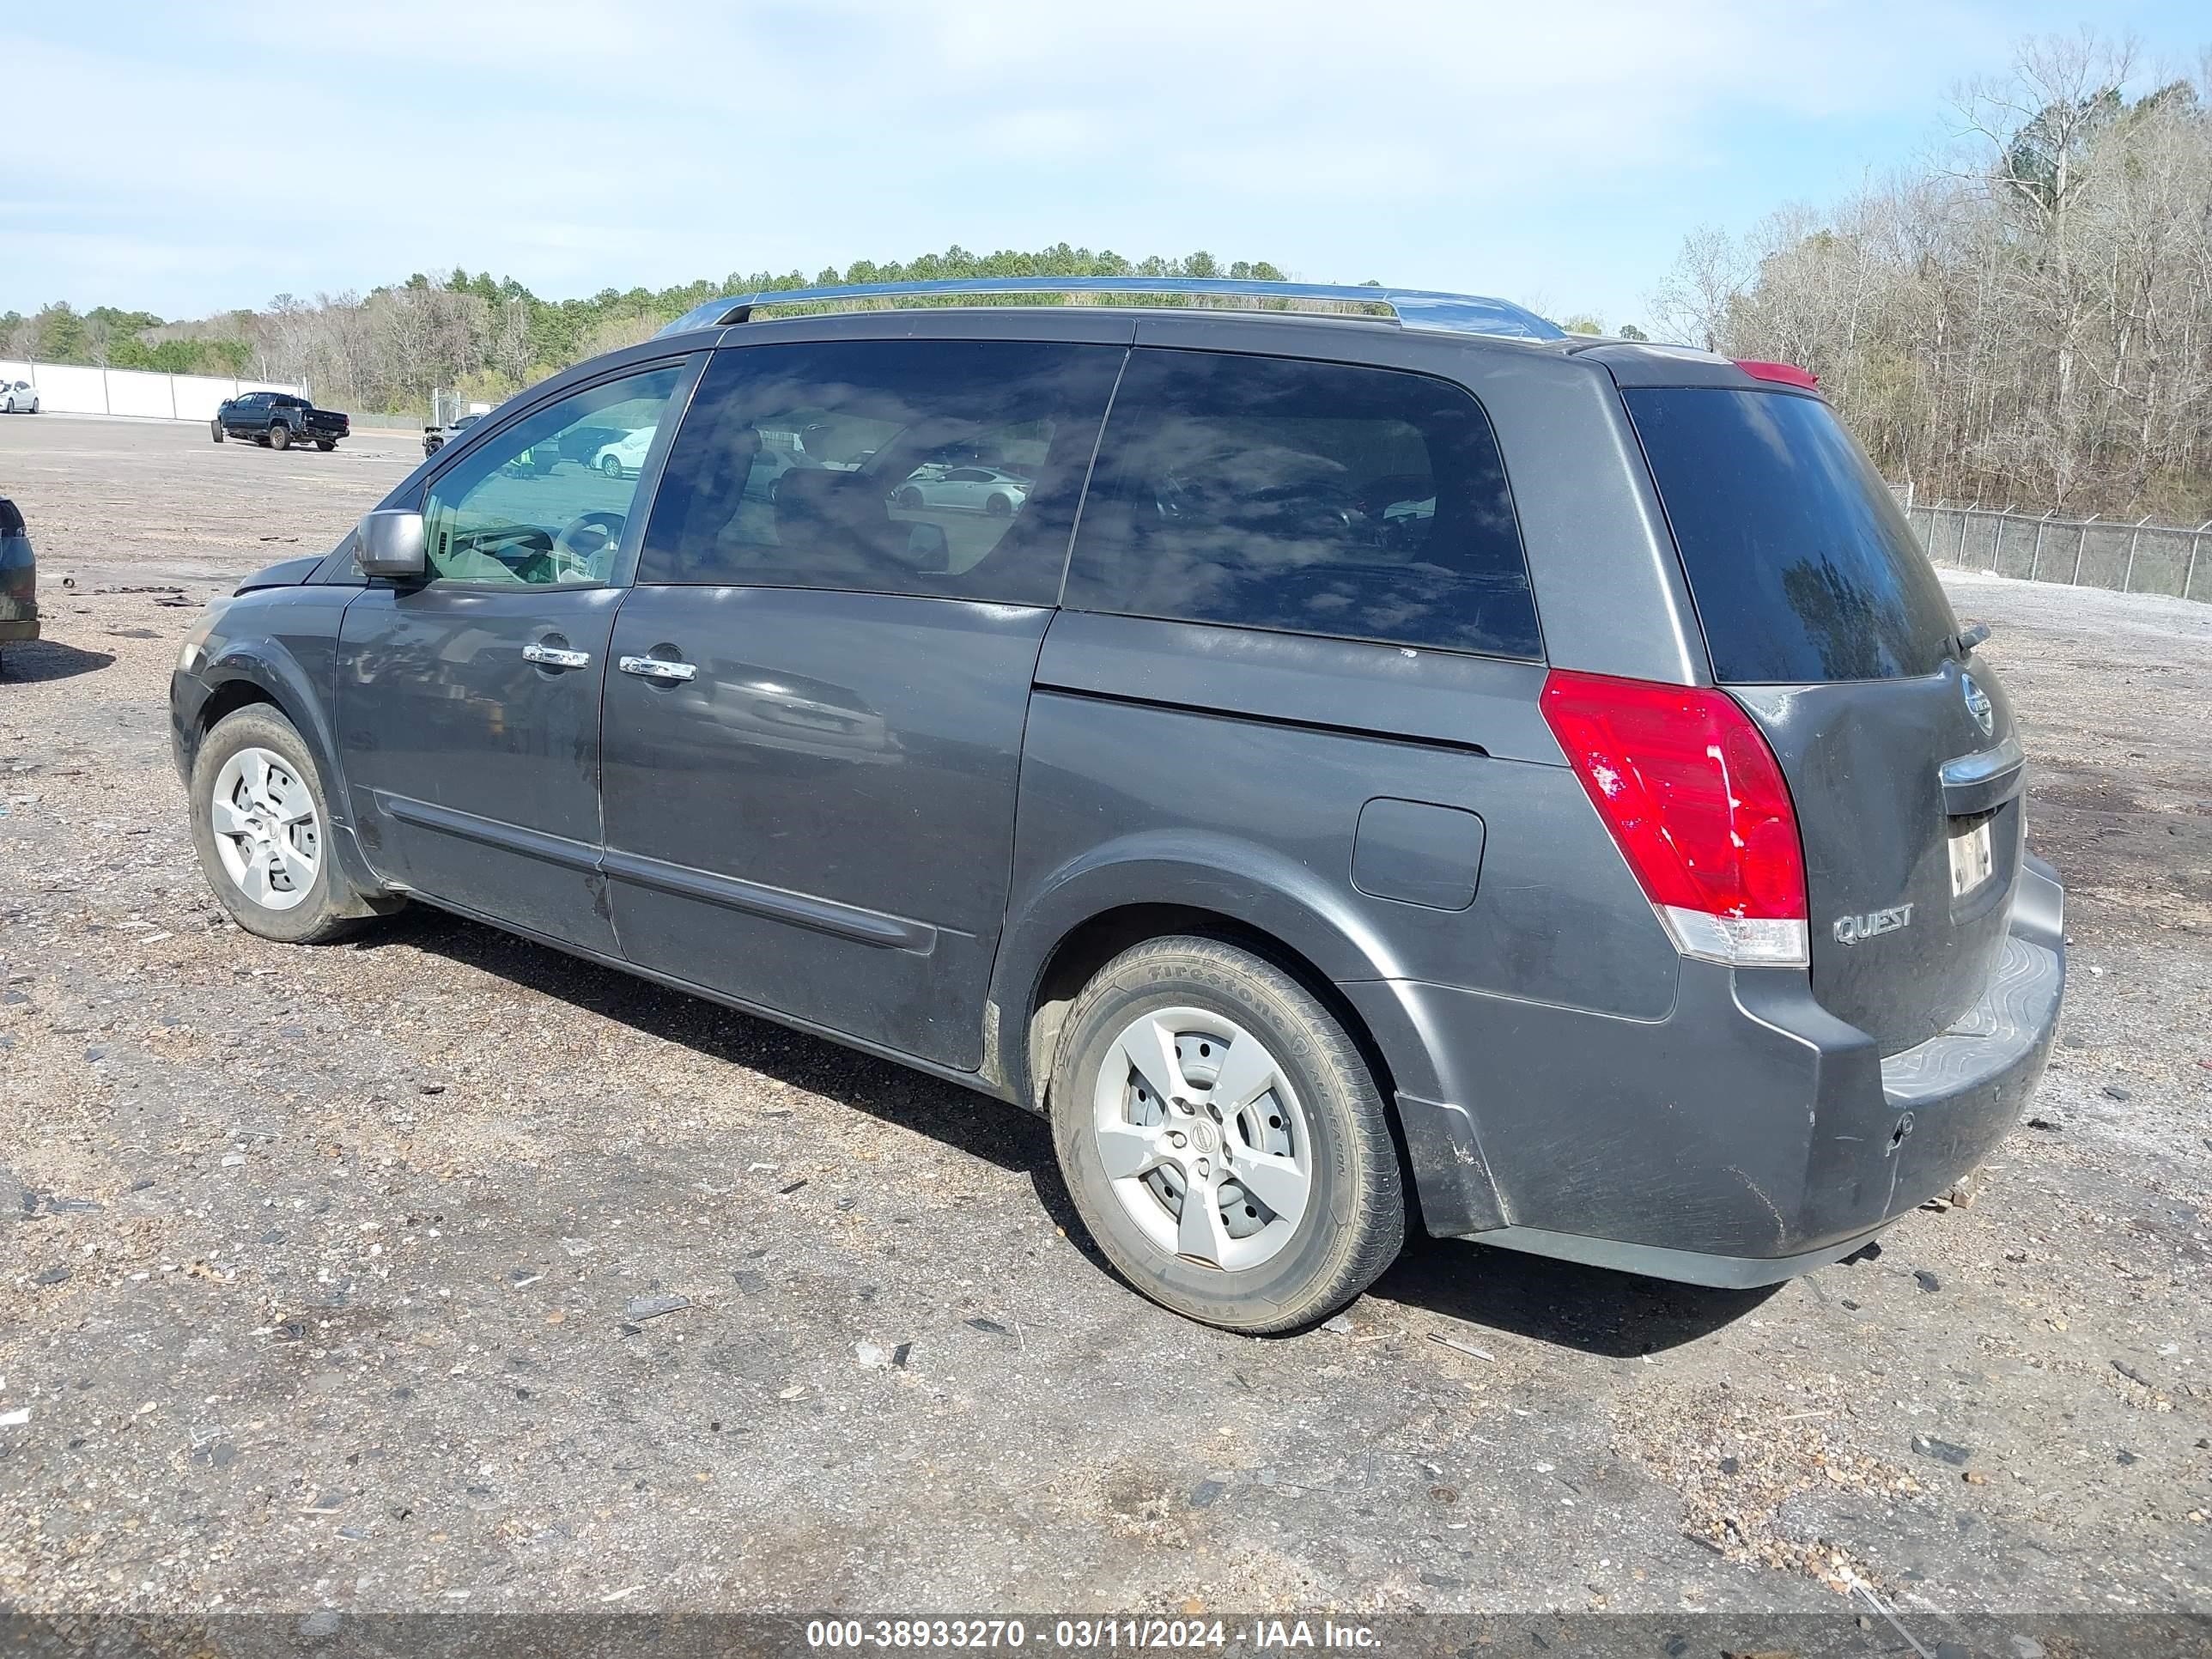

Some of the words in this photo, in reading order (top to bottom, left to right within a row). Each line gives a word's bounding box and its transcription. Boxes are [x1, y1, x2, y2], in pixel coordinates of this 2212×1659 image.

[1833, 902, 1914, 945] QUEST
[1310, 1069, 1330, 1101] ALL
[1323, 1104, 1347, 1178] SEASON
